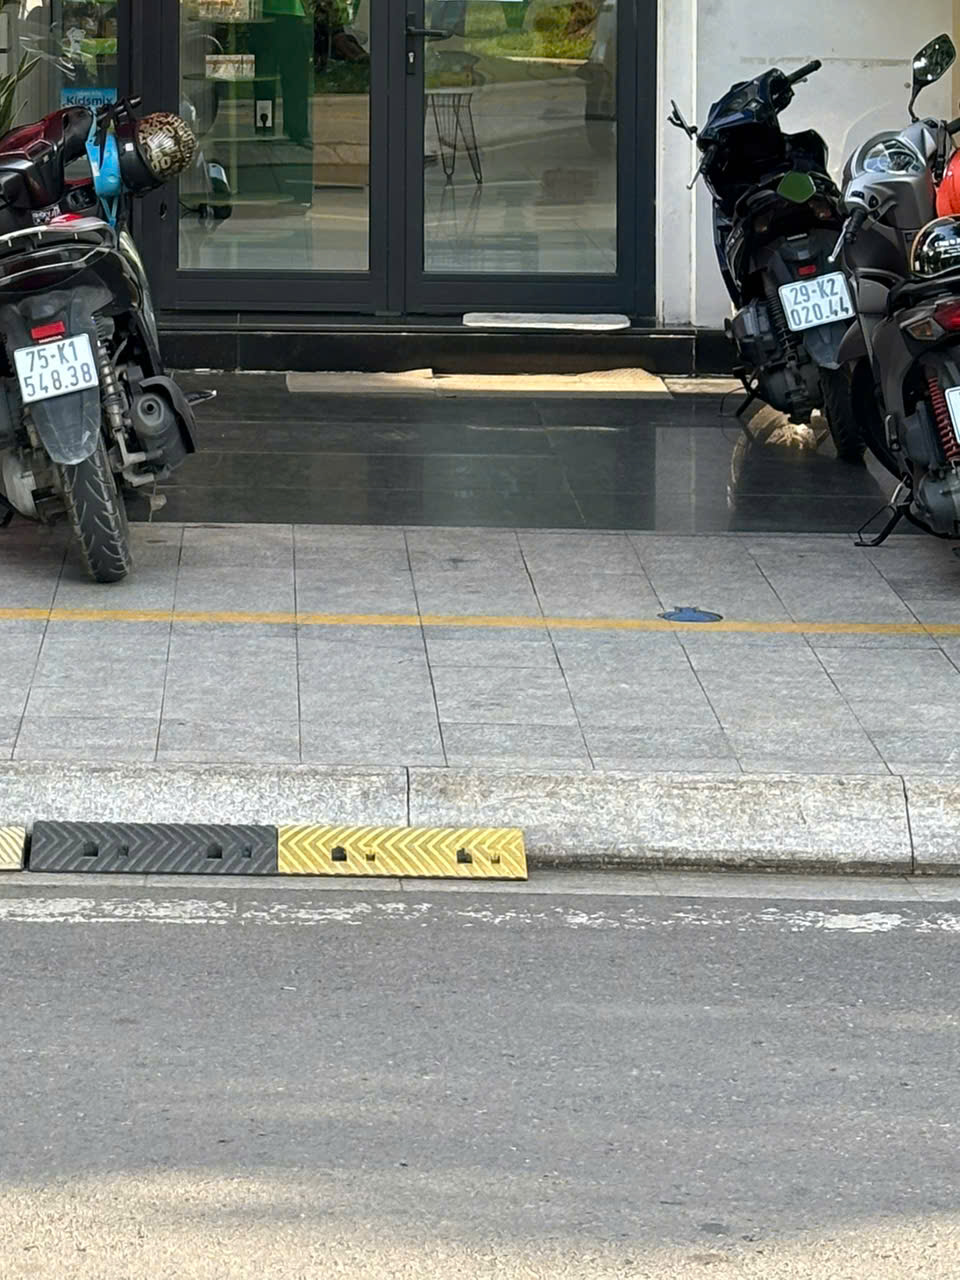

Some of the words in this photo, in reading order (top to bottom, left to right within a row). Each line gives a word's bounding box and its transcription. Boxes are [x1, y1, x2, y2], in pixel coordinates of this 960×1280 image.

[66, 95, 113, 106] Kidsmix
[790, 278, 838, 306] 29-K2
[790, 296, 849, 326] 020.44
[25, 340, 78, 373] 75-K1
[23, 362, 93, 397] 548.38
